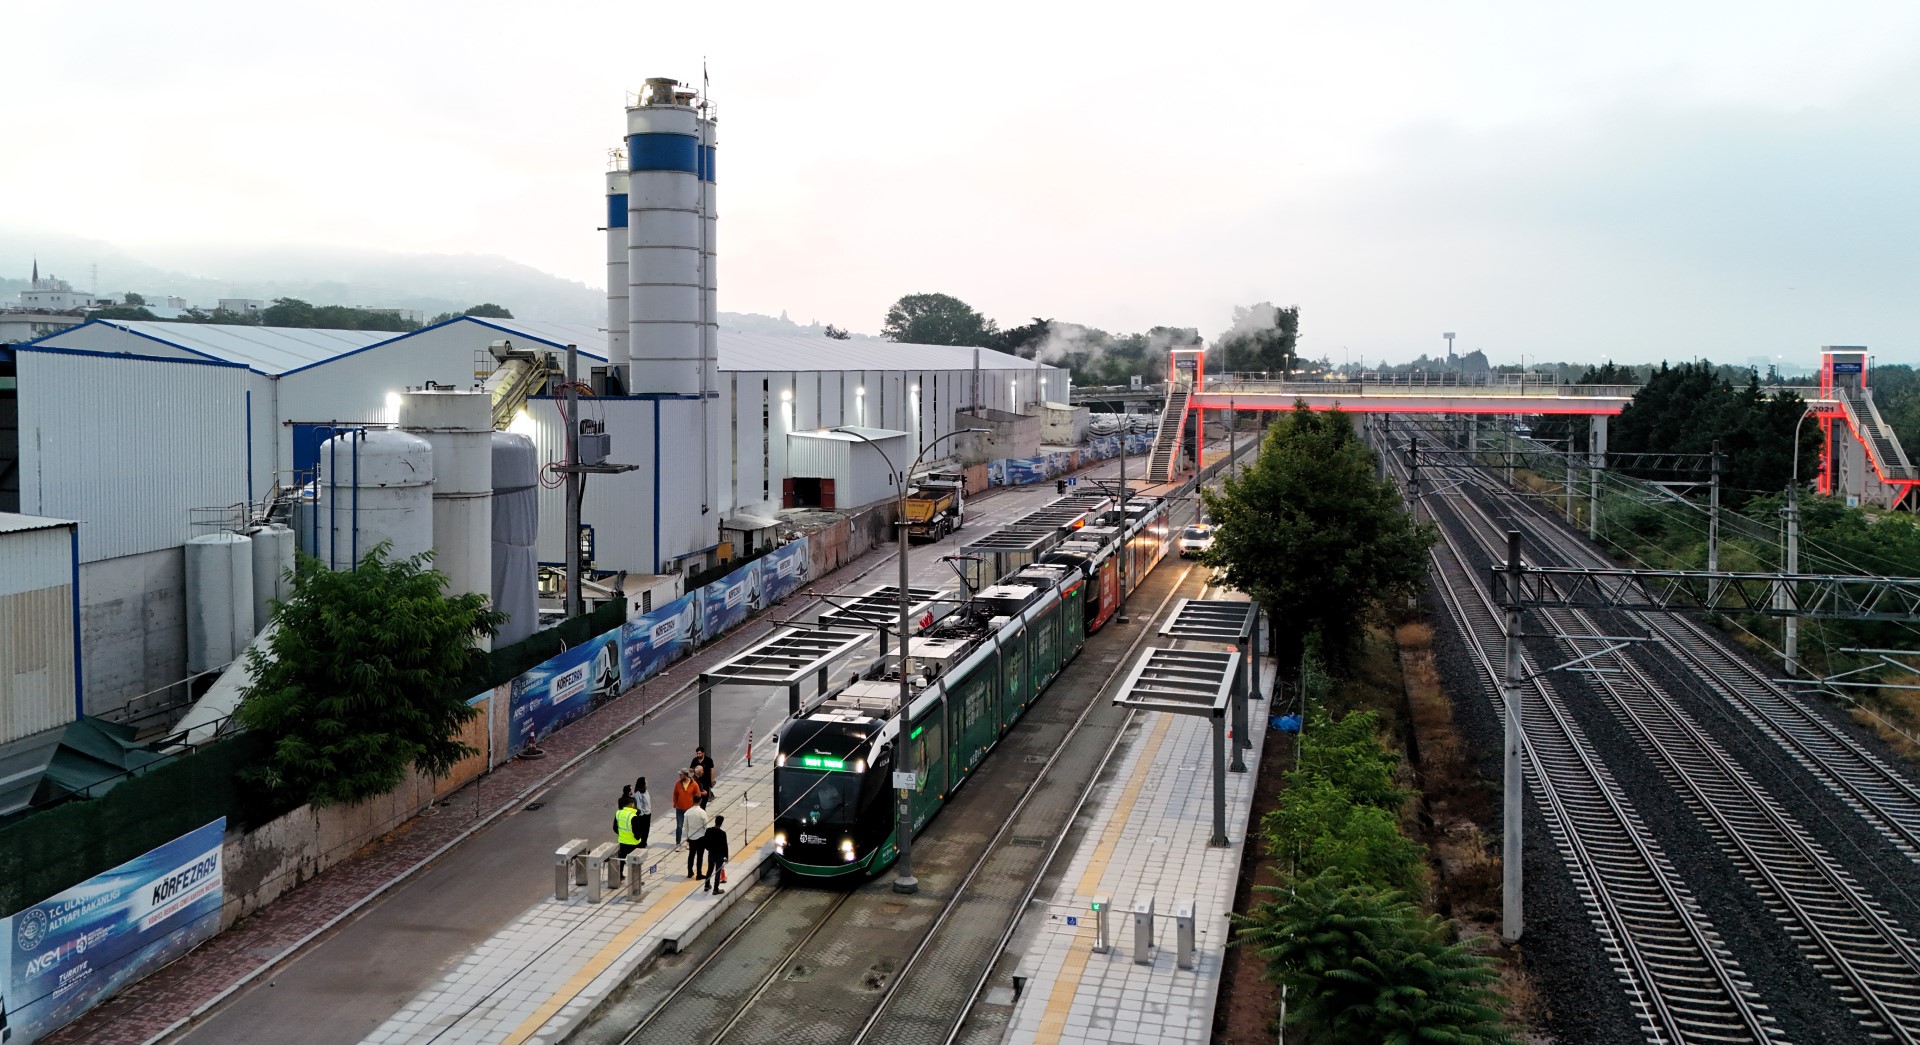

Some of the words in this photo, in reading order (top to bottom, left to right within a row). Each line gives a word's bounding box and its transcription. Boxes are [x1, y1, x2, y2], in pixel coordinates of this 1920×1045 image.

[152, 853, 218, 906] KÖRFEZRAY
[49, 906, 63, 919] T.C.
[49, 908, 80, 932] ALTYAPI
